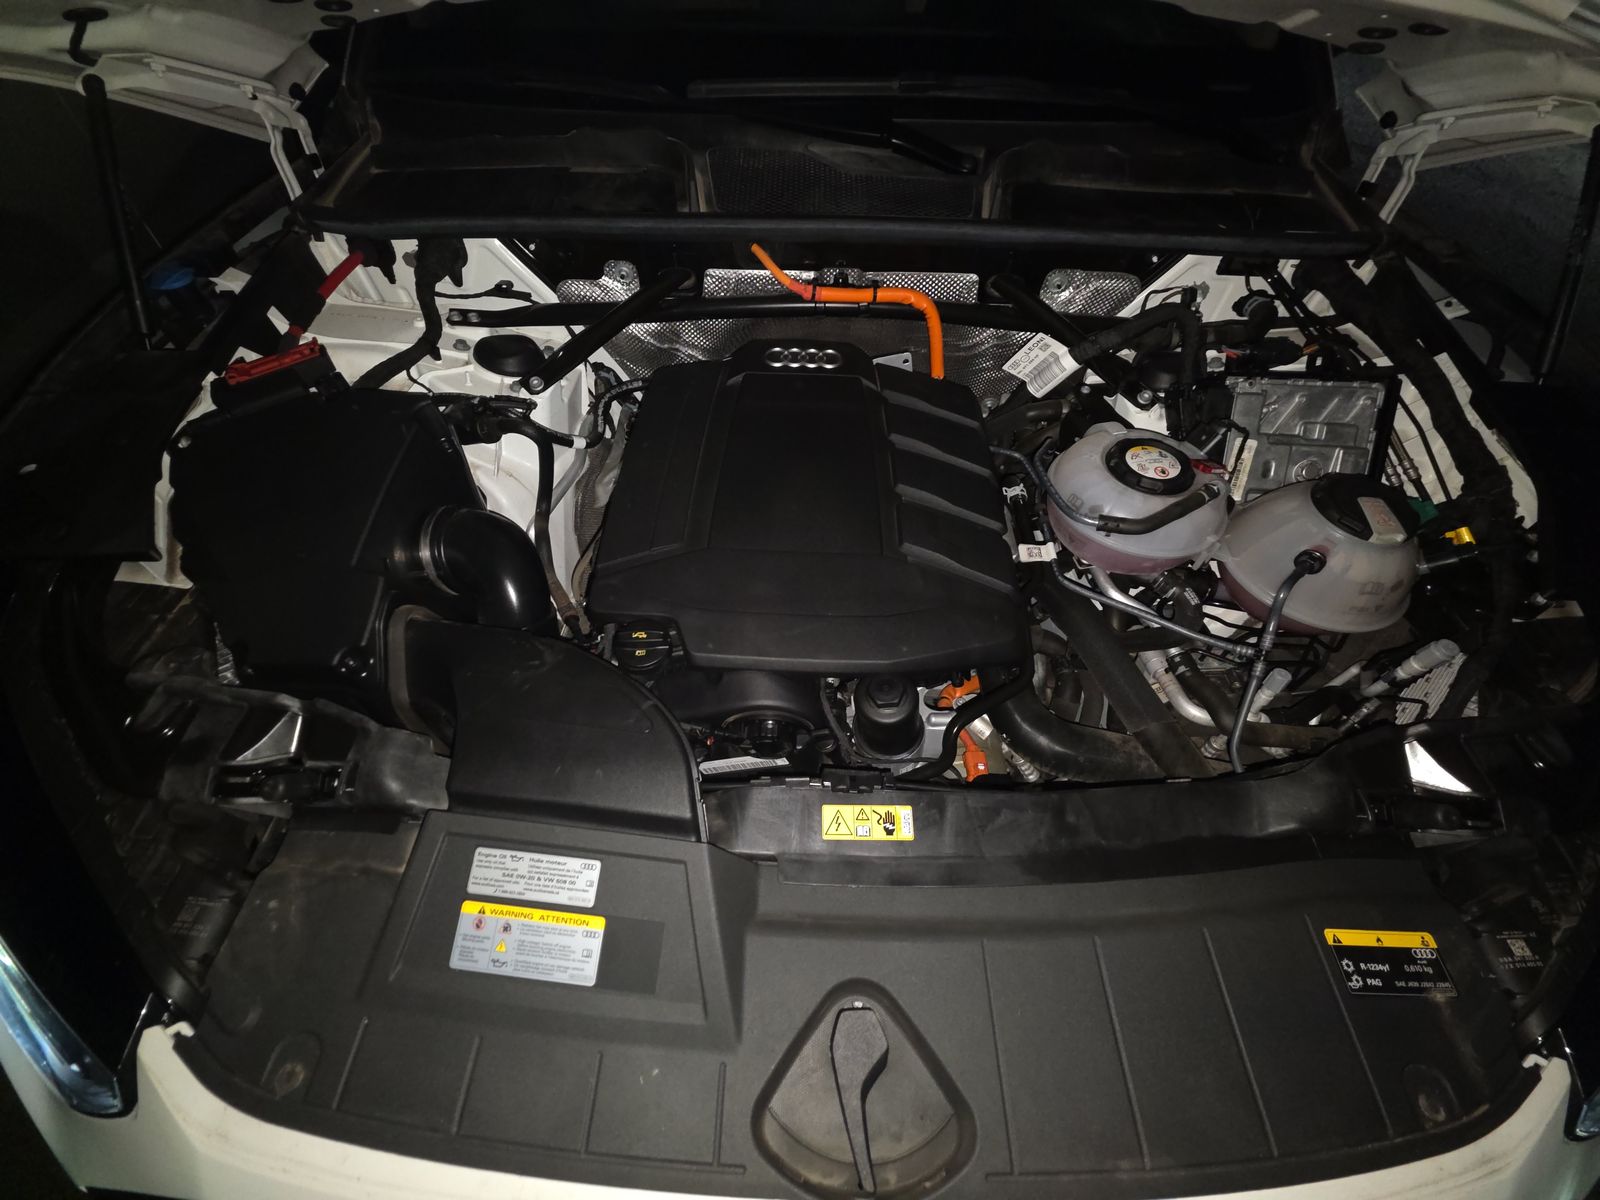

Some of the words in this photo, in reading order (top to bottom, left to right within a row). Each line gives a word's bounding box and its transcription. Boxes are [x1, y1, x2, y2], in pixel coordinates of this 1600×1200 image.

[1024, 336, 1046, 355] LEONI
[477, 851, 498, 859] Engine
[489, 908, 534, 920] WARNING
[538, 914, 590, 926] ATTENTION
[1423, 965, 1433, 974] kg
[1366, 978, 1382, 986] PAG
